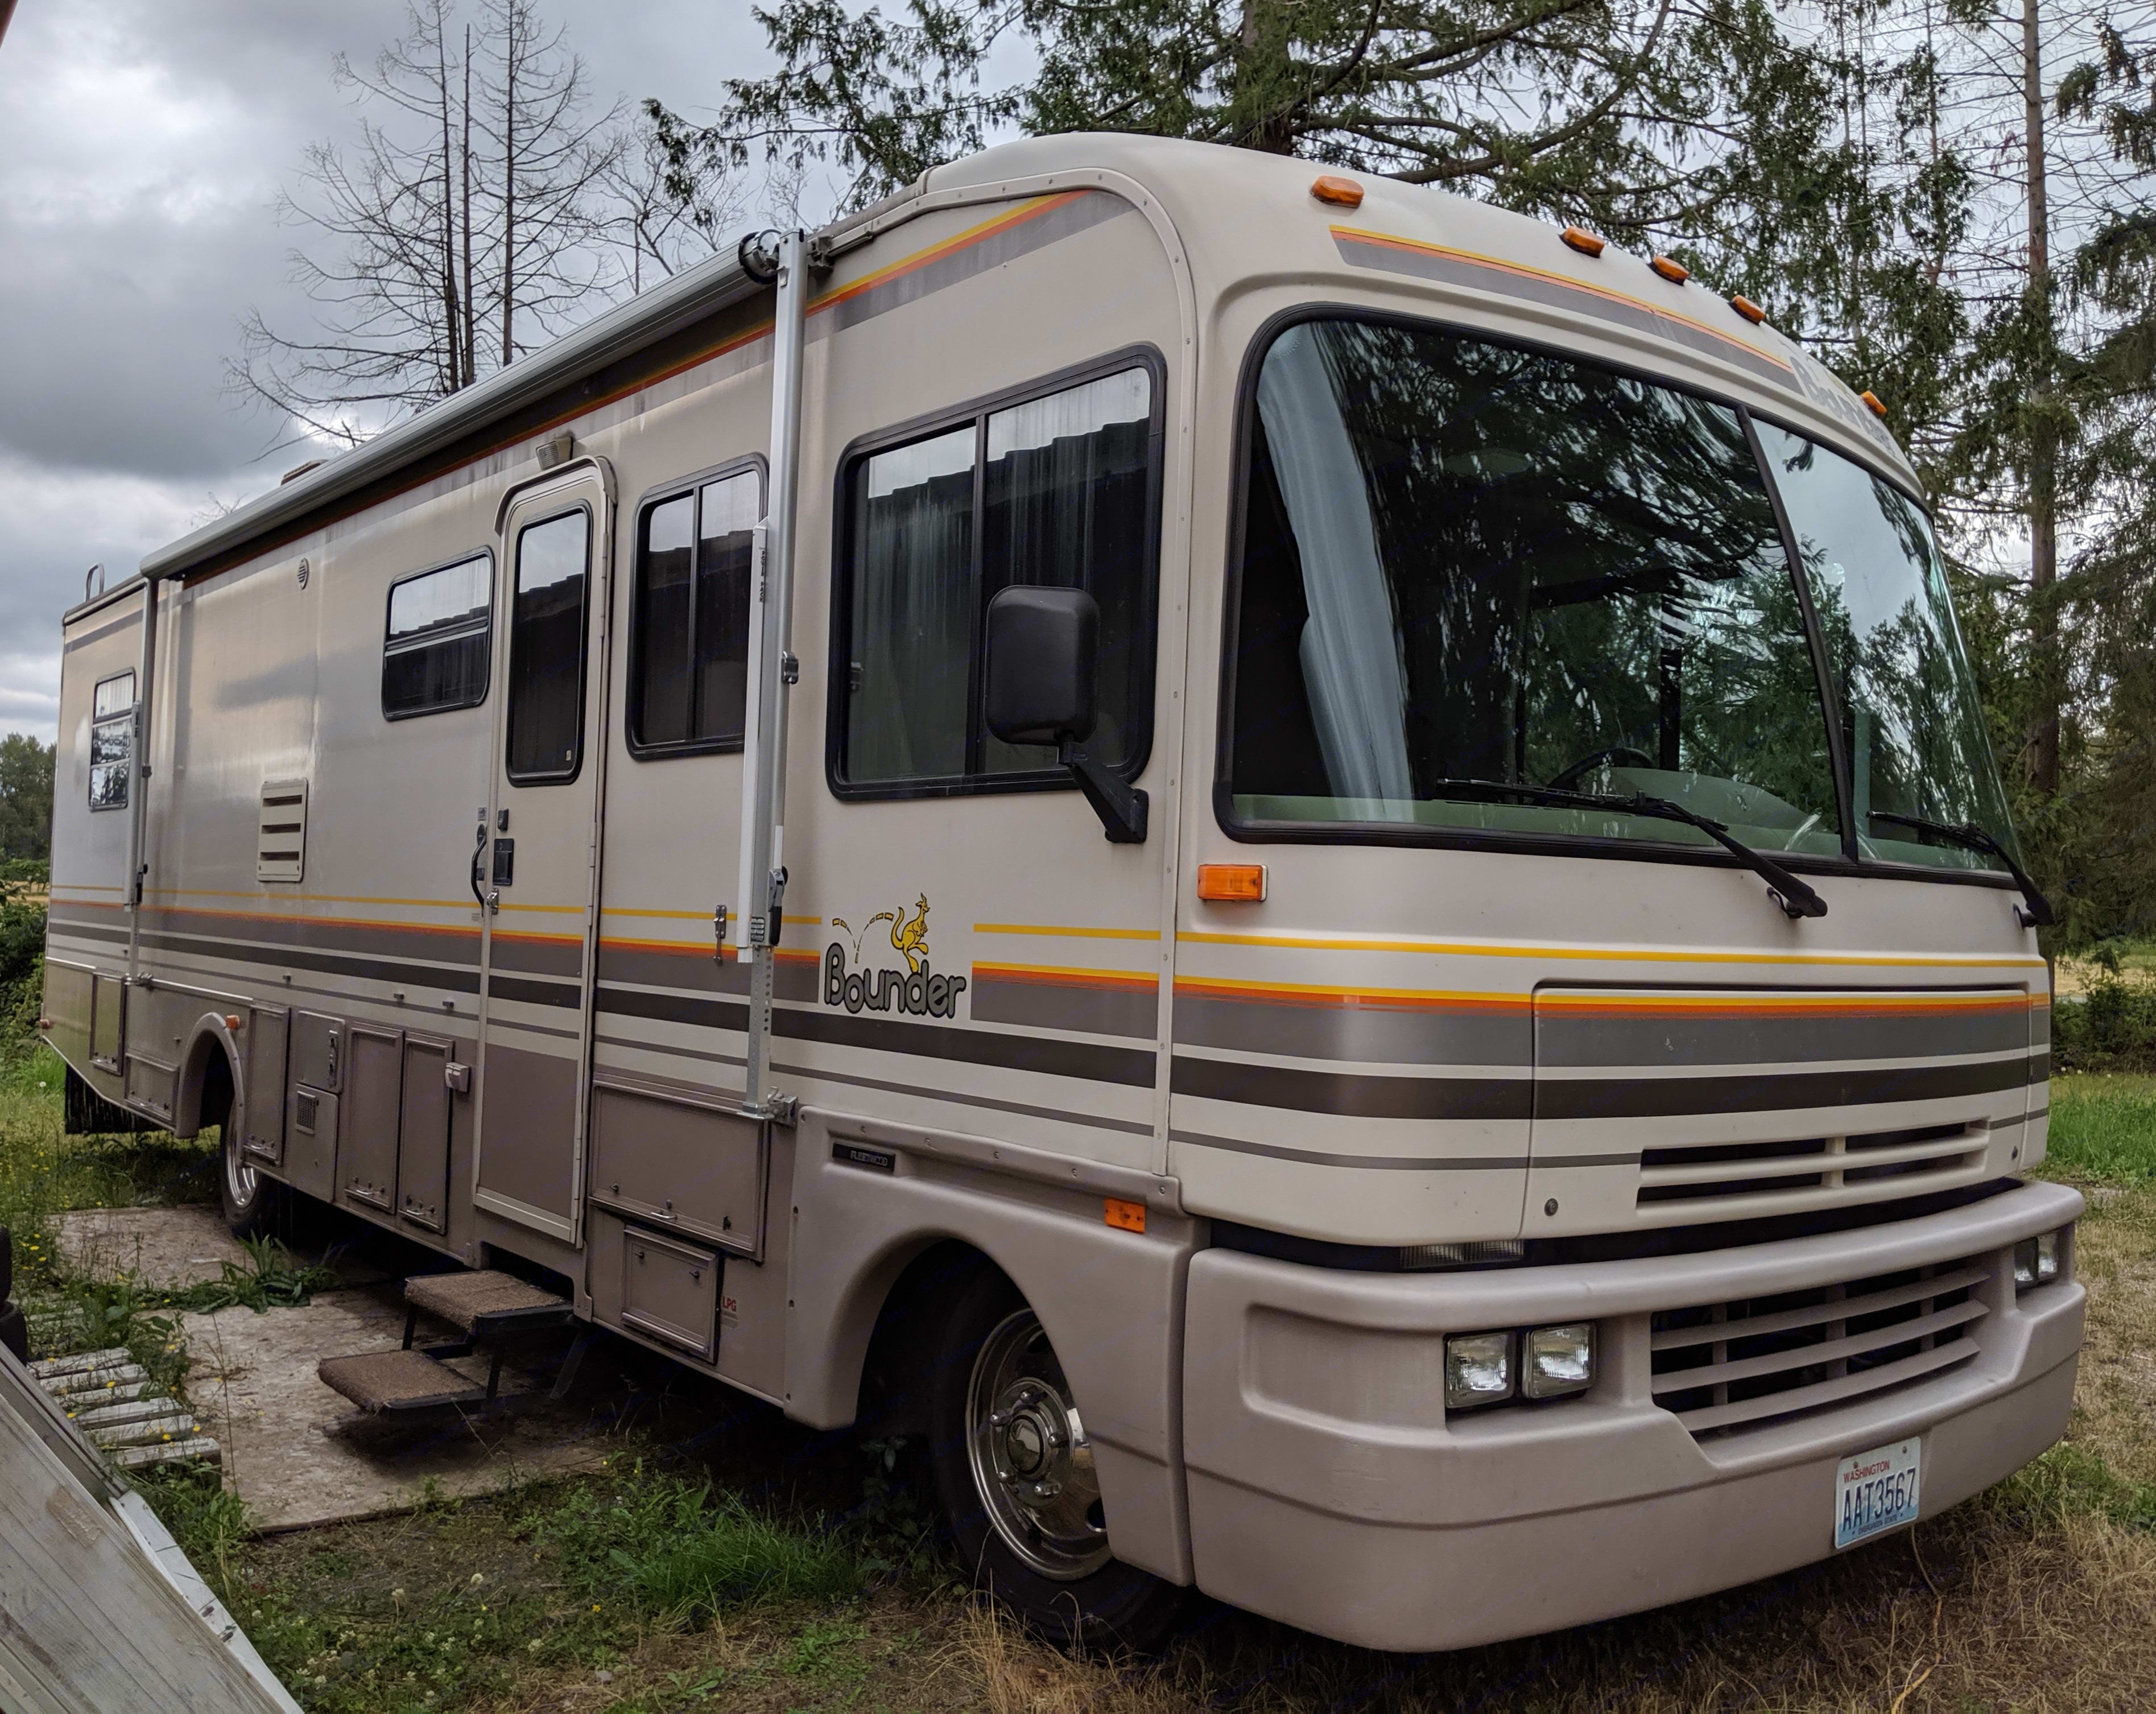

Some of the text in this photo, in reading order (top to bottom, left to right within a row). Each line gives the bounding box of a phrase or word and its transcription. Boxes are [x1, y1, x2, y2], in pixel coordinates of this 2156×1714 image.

[824, 942, 967, 1019] Bounder
[723, 1296, 736, 1311] LPG
[1843, 1460, 1890, 1484] WASHINGTON
[1842, 1468, 1916, 1532] AAT3567
